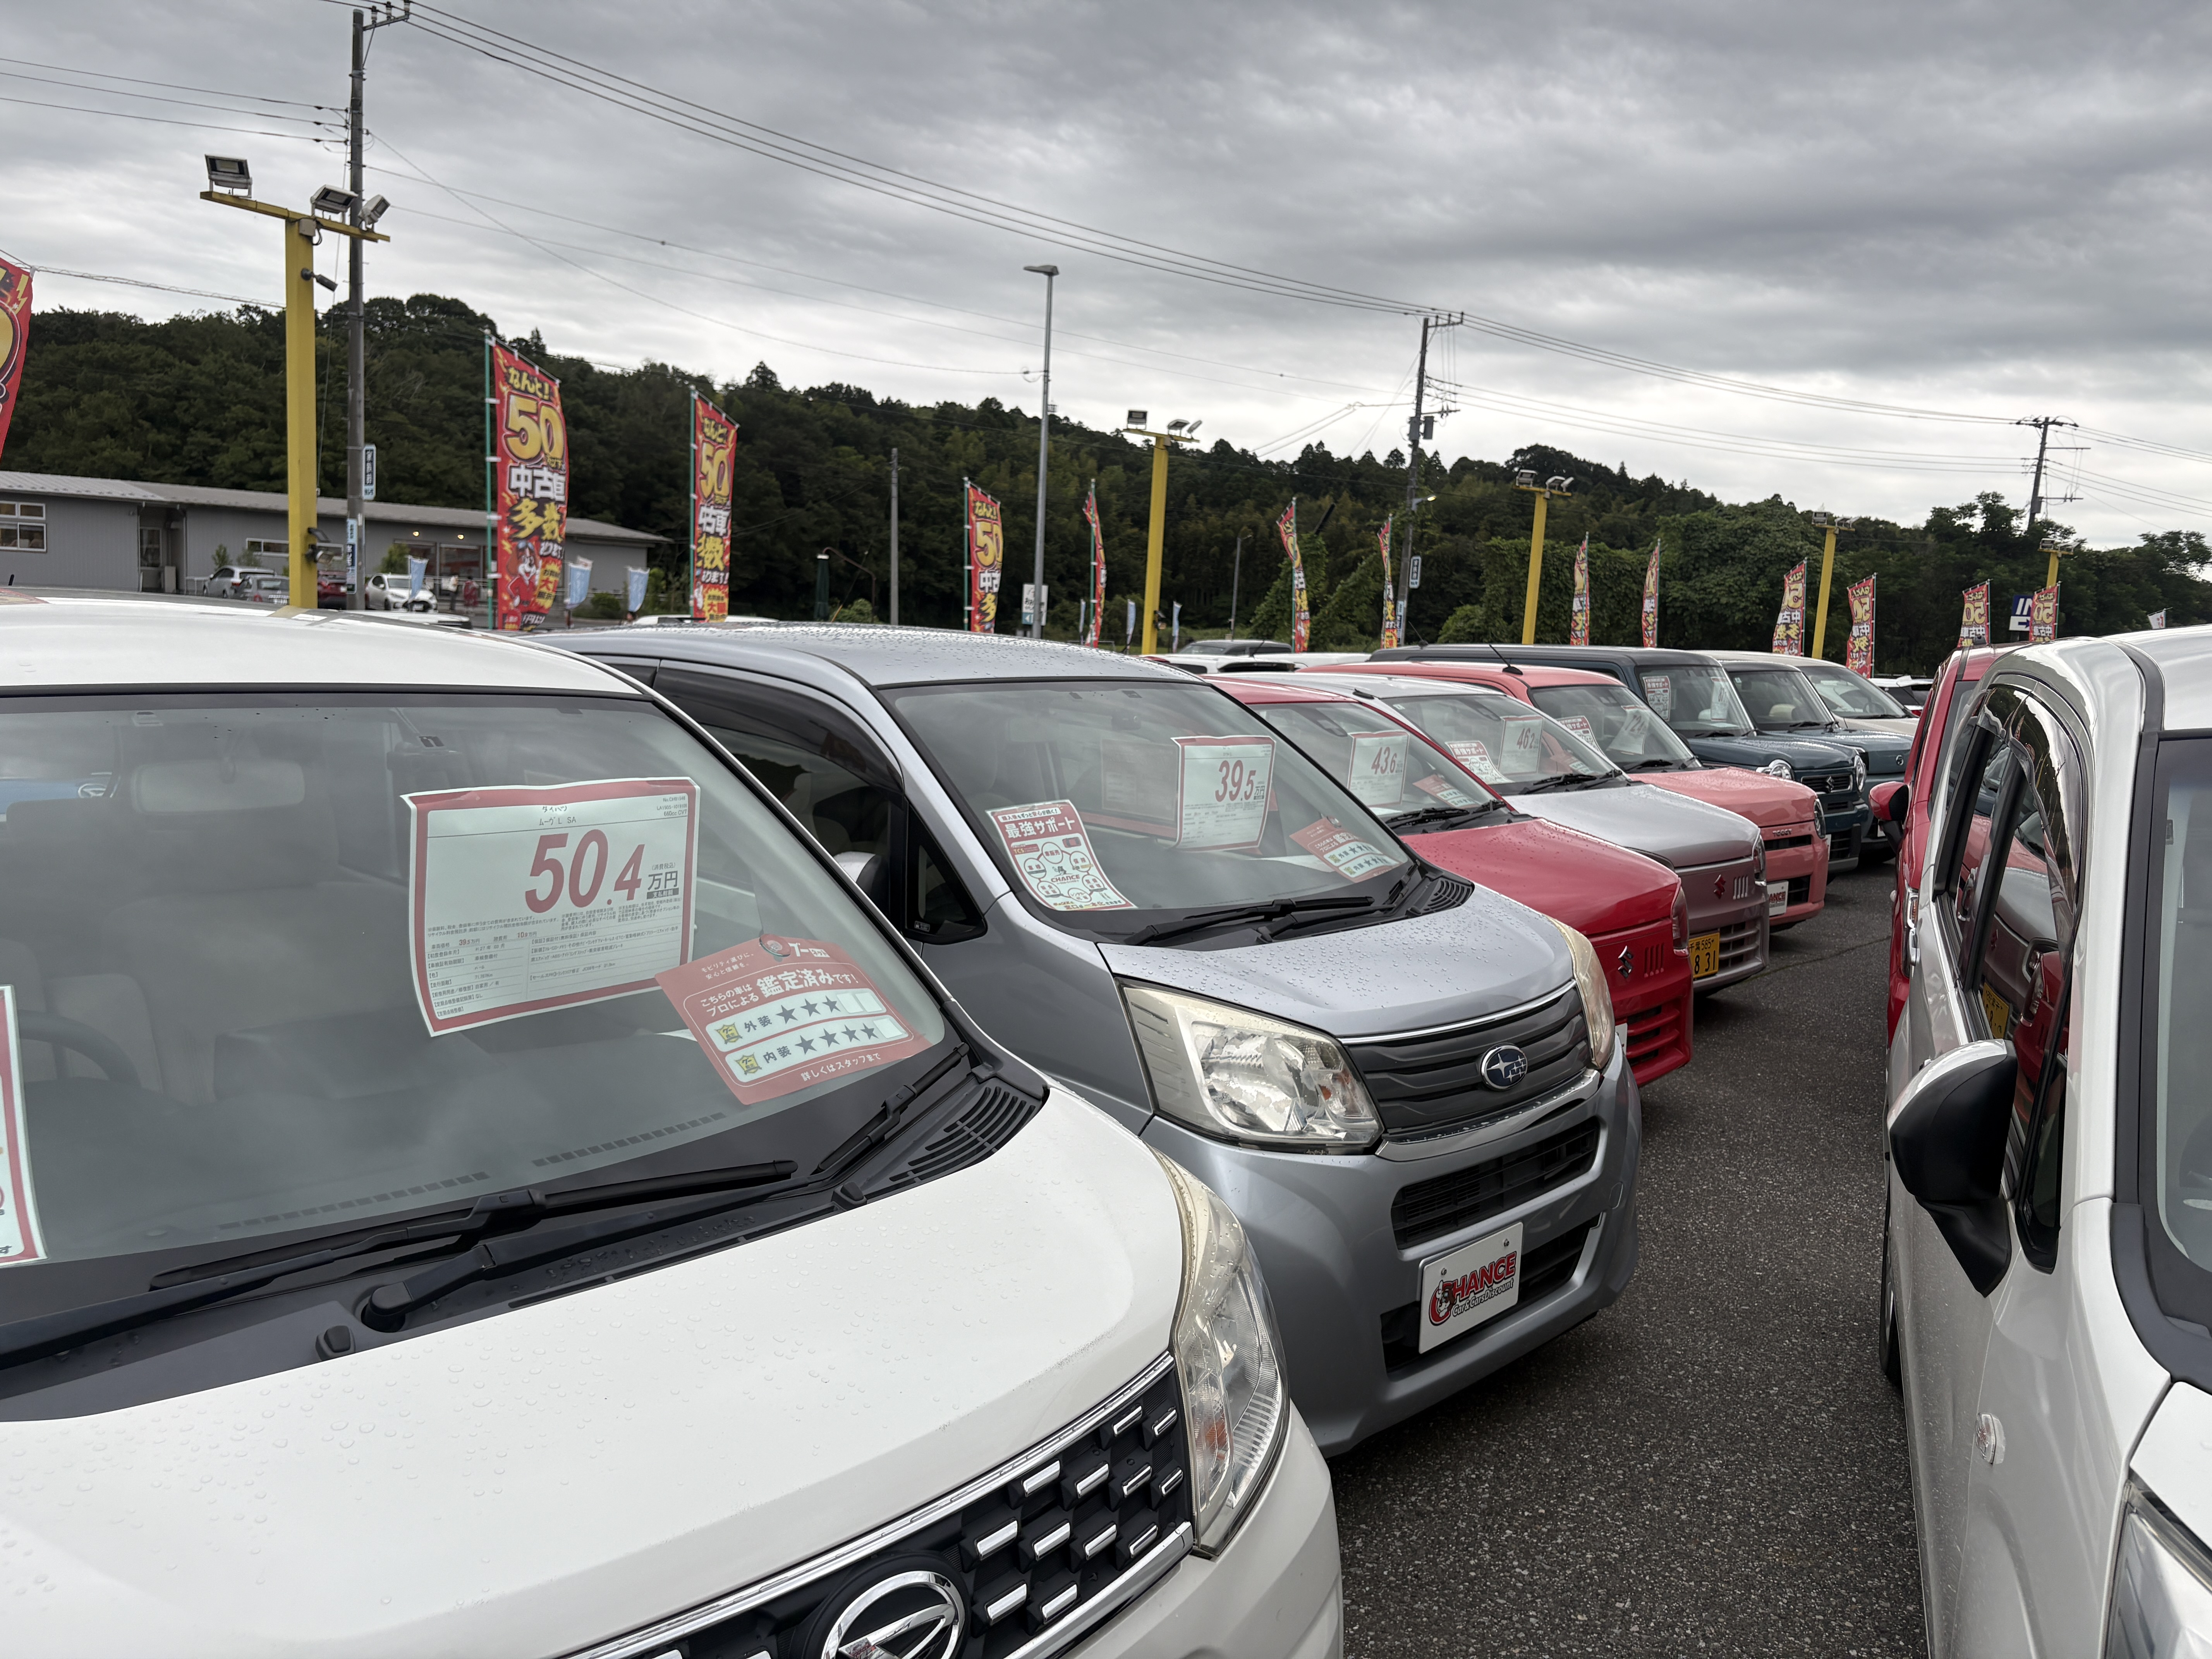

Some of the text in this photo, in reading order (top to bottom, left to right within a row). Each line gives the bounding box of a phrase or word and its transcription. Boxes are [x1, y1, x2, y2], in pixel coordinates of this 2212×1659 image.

[508, 367, 549, 399] なんと!
[506, 394, 564, 460] 50
[701, 443, 730, 498] 50
[1215, 760, 1265, 802] 39.5 万円
[1005, 817, 1075, 839] 最強サポート
[525, 829, 678, 913] 50.4 万円
[1769, 891, 1786, 903] ANCE
[1701, 938, 1711, 951] 585
[701, 983, 752, 1006] こちらの車は
[707, 993, 759, 1017] プロによる
[744, 1015, 773, 1033] 外装
[763, 1046, 792, 1063] 内装
[800, 1052, 881, 1082] 詳しくはスタッフまで
